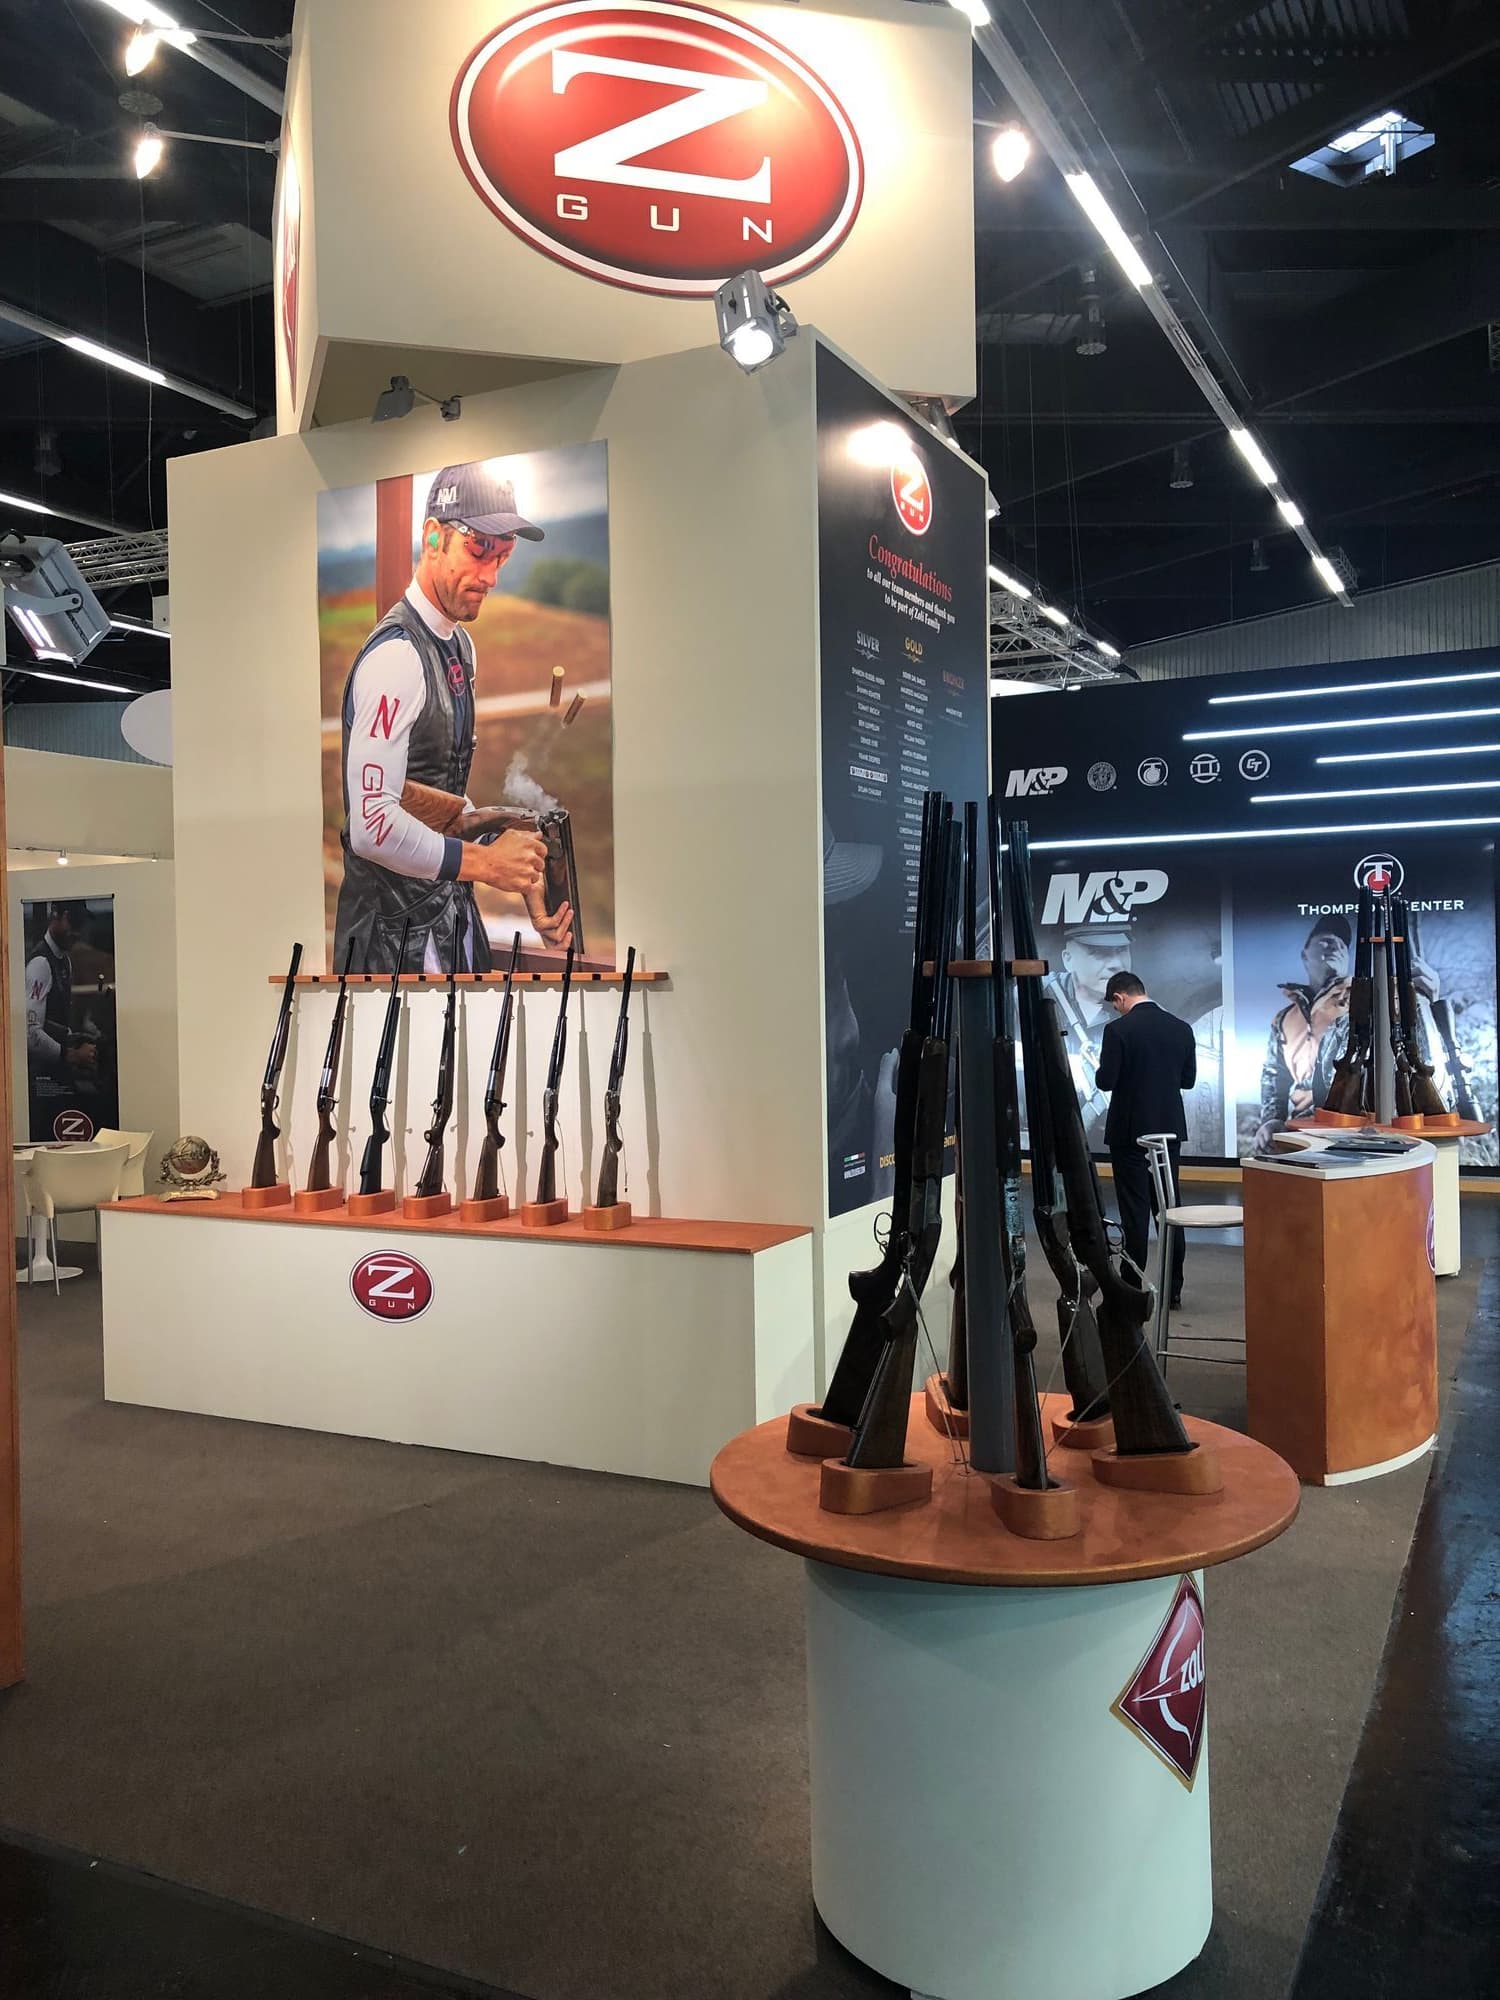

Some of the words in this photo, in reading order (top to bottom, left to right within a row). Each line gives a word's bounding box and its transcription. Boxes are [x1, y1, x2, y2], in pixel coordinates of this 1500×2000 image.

[551, 48, 771, 204] Z
[556, 193, 773, 243] GUN
[868, 534, 953, 602] Congratulations
[867, 566, 872, 580] to
[873, 568, 881, 584] all
[881, 576, 890, 590] our
[891, 580, 903, 597] team
[924, 597, 933, 613] and
[947, 612, 955, 627] you
[884, 591, 889, 605] to
[891, 594, 896, 608] be
[897, 598, 907, 617] part
[908, 604, 913, 620] of
[925, 612, 940, 634] Family
[856, 630, 880, 653] SILVER
[905, 637, 923, 656] GOLD
[1005, 766, 1068, 798] M&P
[361, 763, 394, 847] GUN
[1041, 868, 1169, 925] M&P
[1297, 903, 1393, 916] THOMPS
[1400, 899, 1465, 912] ENTER
[61, 1117, 85, 1136] Z
[368, 1264, 415, 1299] Z
[369, 1299, 415, 1310] GUN
